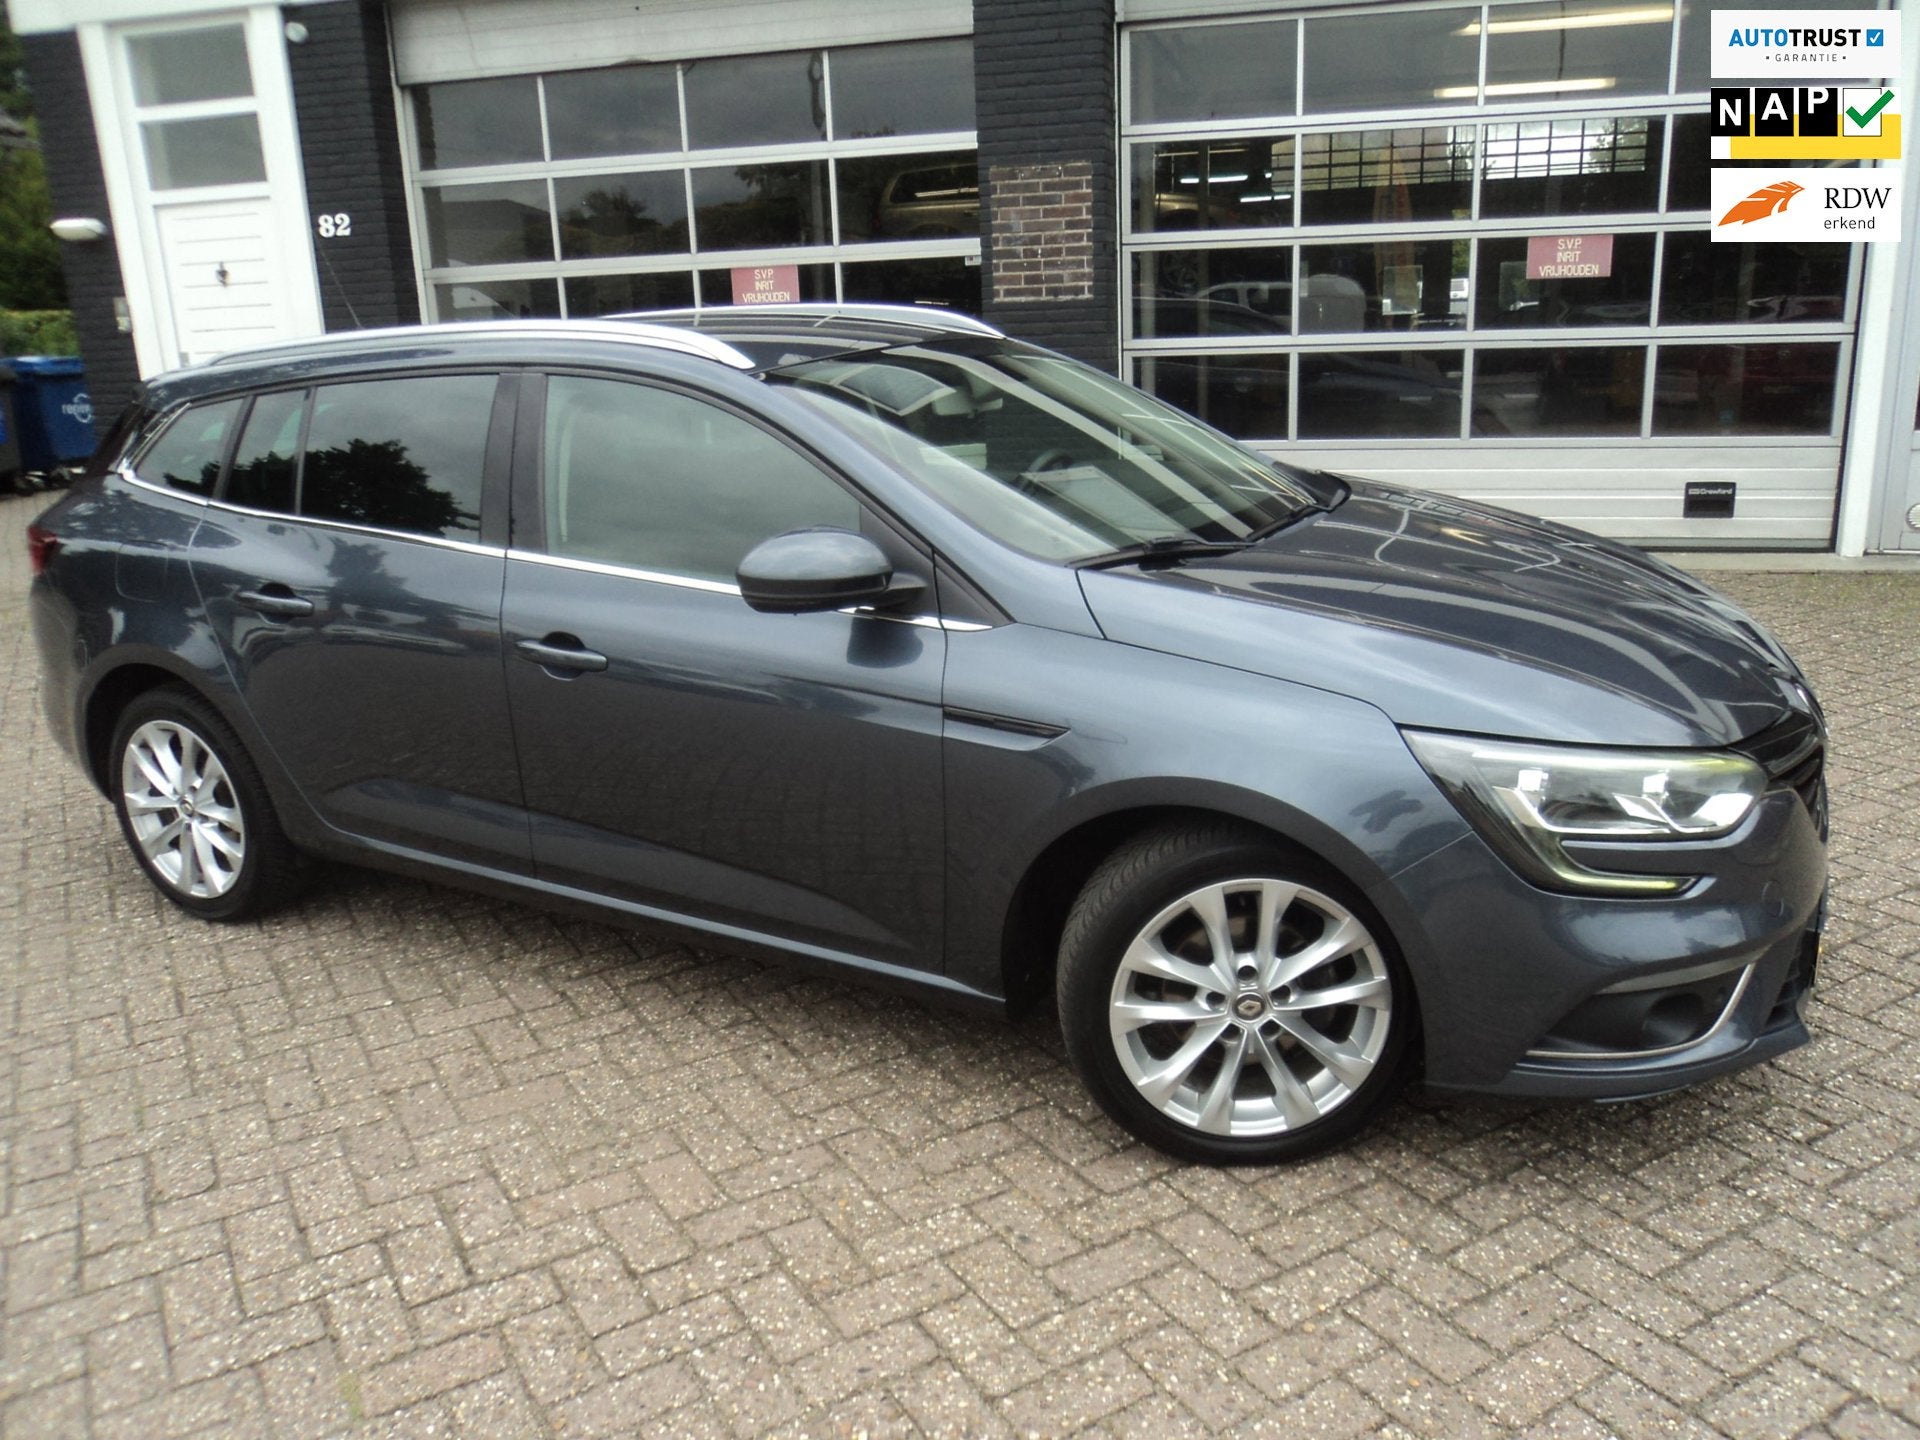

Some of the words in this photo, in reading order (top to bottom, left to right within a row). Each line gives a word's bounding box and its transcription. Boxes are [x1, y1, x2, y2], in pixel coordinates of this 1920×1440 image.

[318, 212, 352, 238] 82
[1556, 251, 1582, 262] INRIT
[1538, 264, 1599, 277] VRIJHOUDEN
